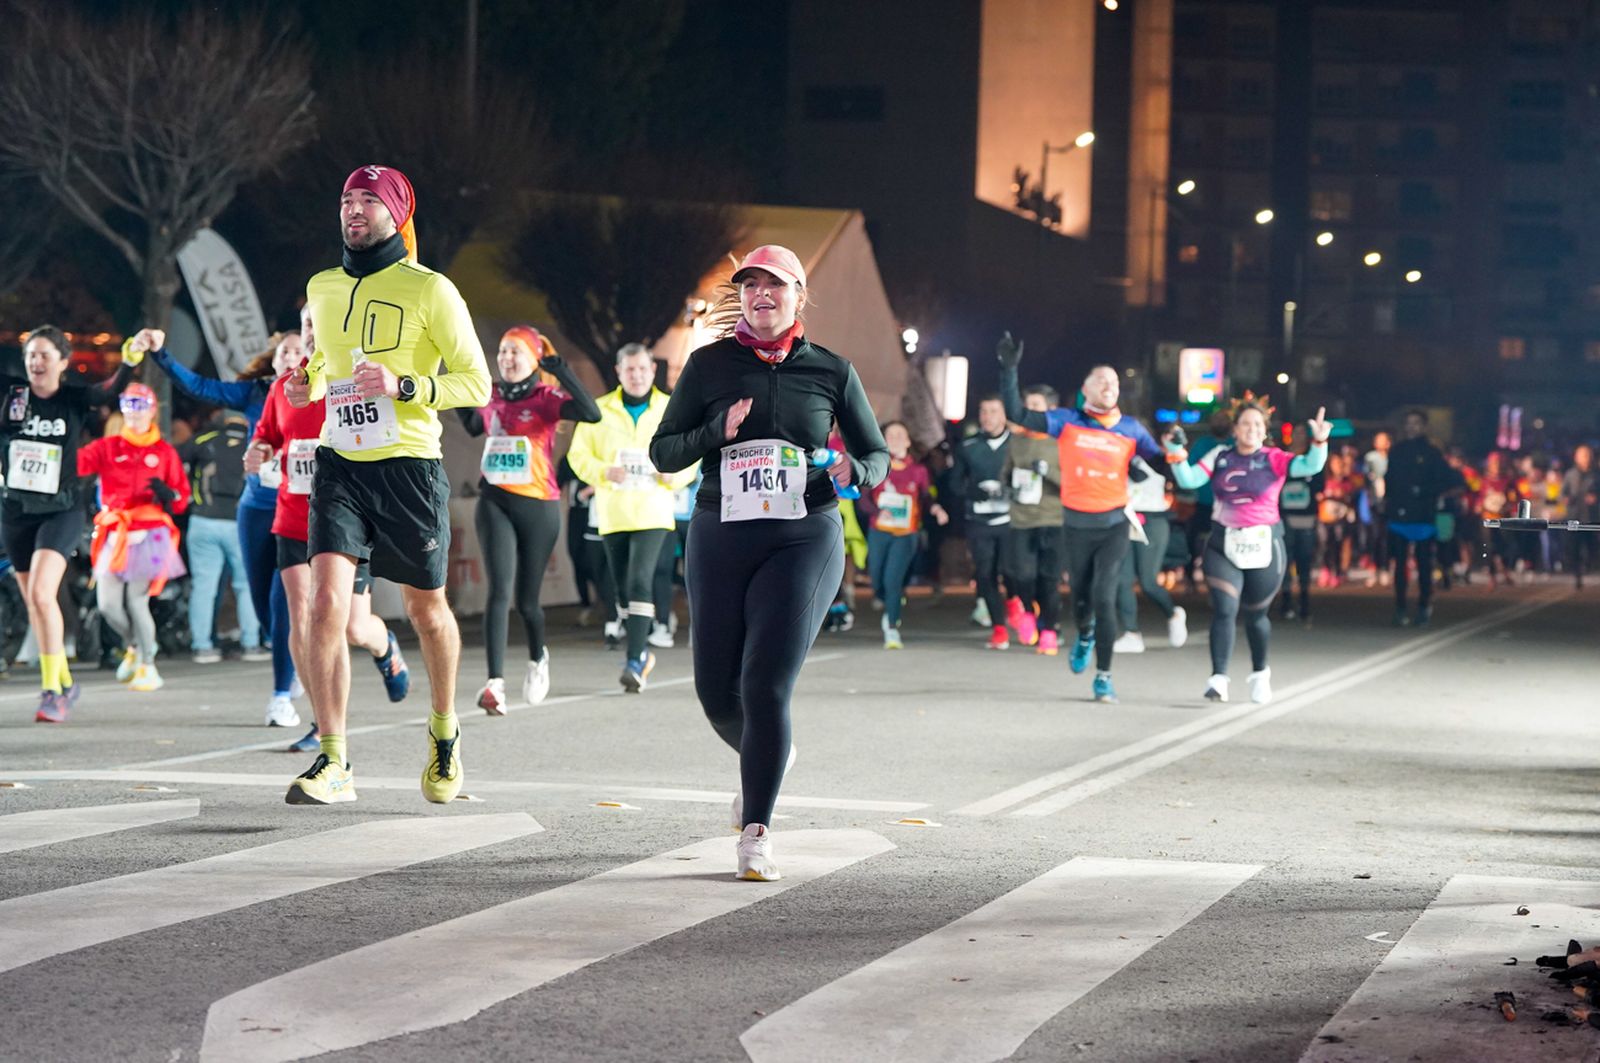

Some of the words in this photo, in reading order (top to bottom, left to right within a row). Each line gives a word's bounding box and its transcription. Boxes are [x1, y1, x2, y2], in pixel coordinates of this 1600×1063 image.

[336, 401, 379, 428] 1465
[487, 453, 526, 469] 12495
[739, 448, 764, 459] NOCHE
[21, 459, 48, 475] 4271
[730, 460, 747, 471] SAN
[739, 468, 789, 493] 1464
